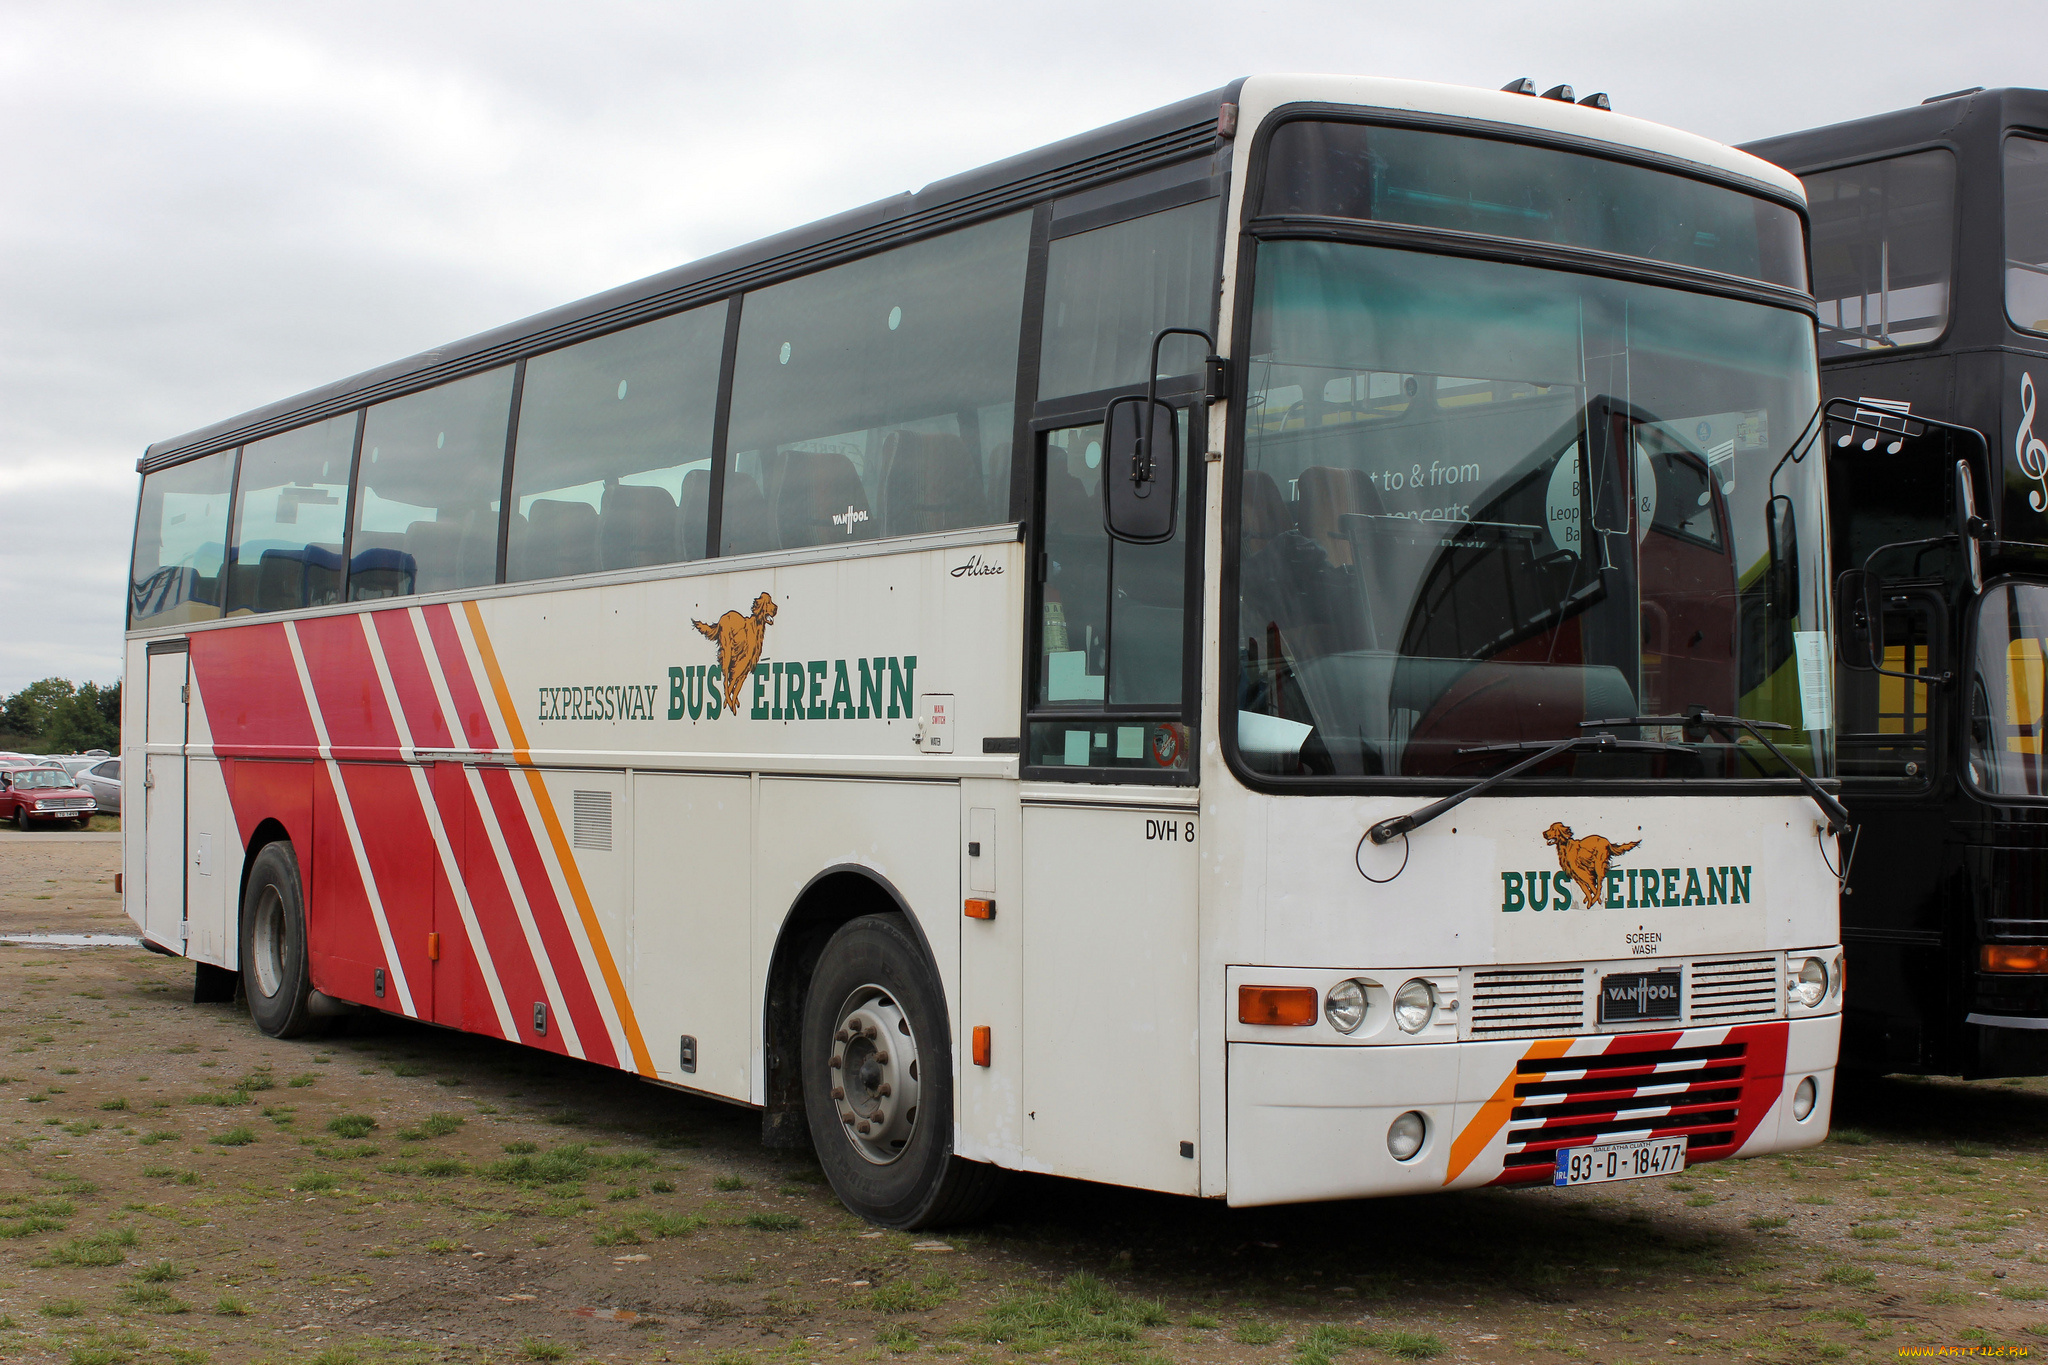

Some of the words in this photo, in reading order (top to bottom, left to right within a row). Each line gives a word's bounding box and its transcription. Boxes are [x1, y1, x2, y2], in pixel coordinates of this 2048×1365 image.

[1383, 469, 1404, 492] to
[1410, 463, 1424, 488] &
[1430, 460, 1480, 487] from
[1640, 496, 1651, 512] &
[538, 685, 658, 721] EXPRESSWAY
[667, 665, 722, 721] BUS
[933, 704, 945, 714] MAIN
[931, 715, 946, 725] SWITCH
[1146, 819, 1178, 842] DVH
[1184, 821, 1195, 843] 8
[1501, 870, 1573, 913] BUS
[1625, 932, 1662, 944] SCREEN
[1631, 944, 1657, 955] WASH
[1593, 1145, 1610, 1153] BAILE
[1629, 1141, 1651, 1149] CLIATH
[1555, 1171, 1568, 1180] IRL
